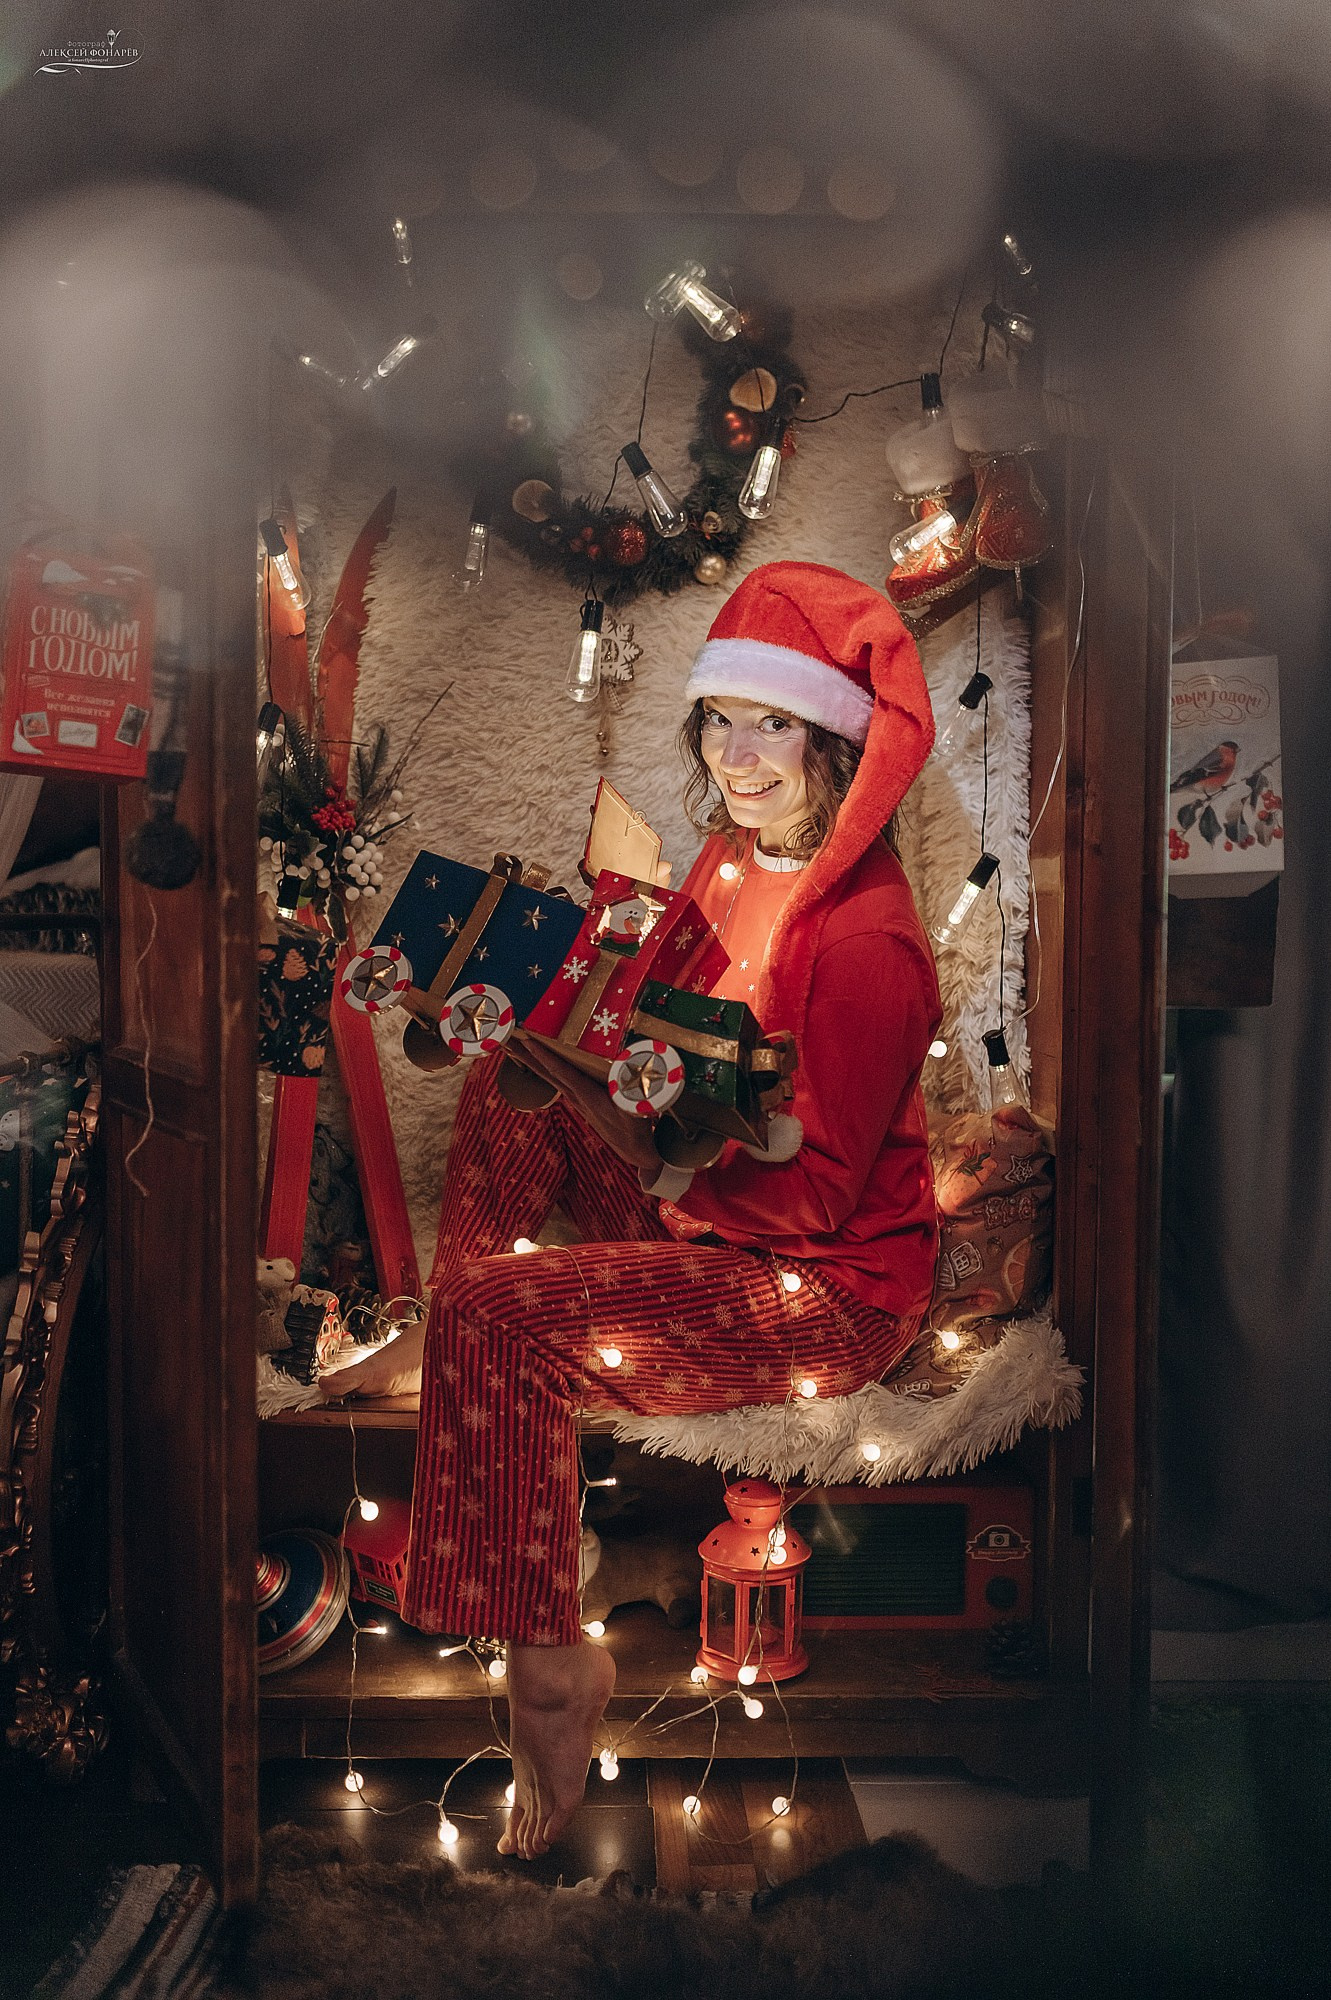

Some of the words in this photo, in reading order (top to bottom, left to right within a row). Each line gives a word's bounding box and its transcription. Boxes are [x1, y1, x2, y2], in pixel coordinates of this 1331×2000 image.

[31, 605, 47, 635] С
[49, 607, 141, 651] НОВЫМ
[28, 635, 138, 682] ГОДОМ!
[44, 688, 65, 700] Все
[1206, 690, 1261, 714] ГОДОМ!
